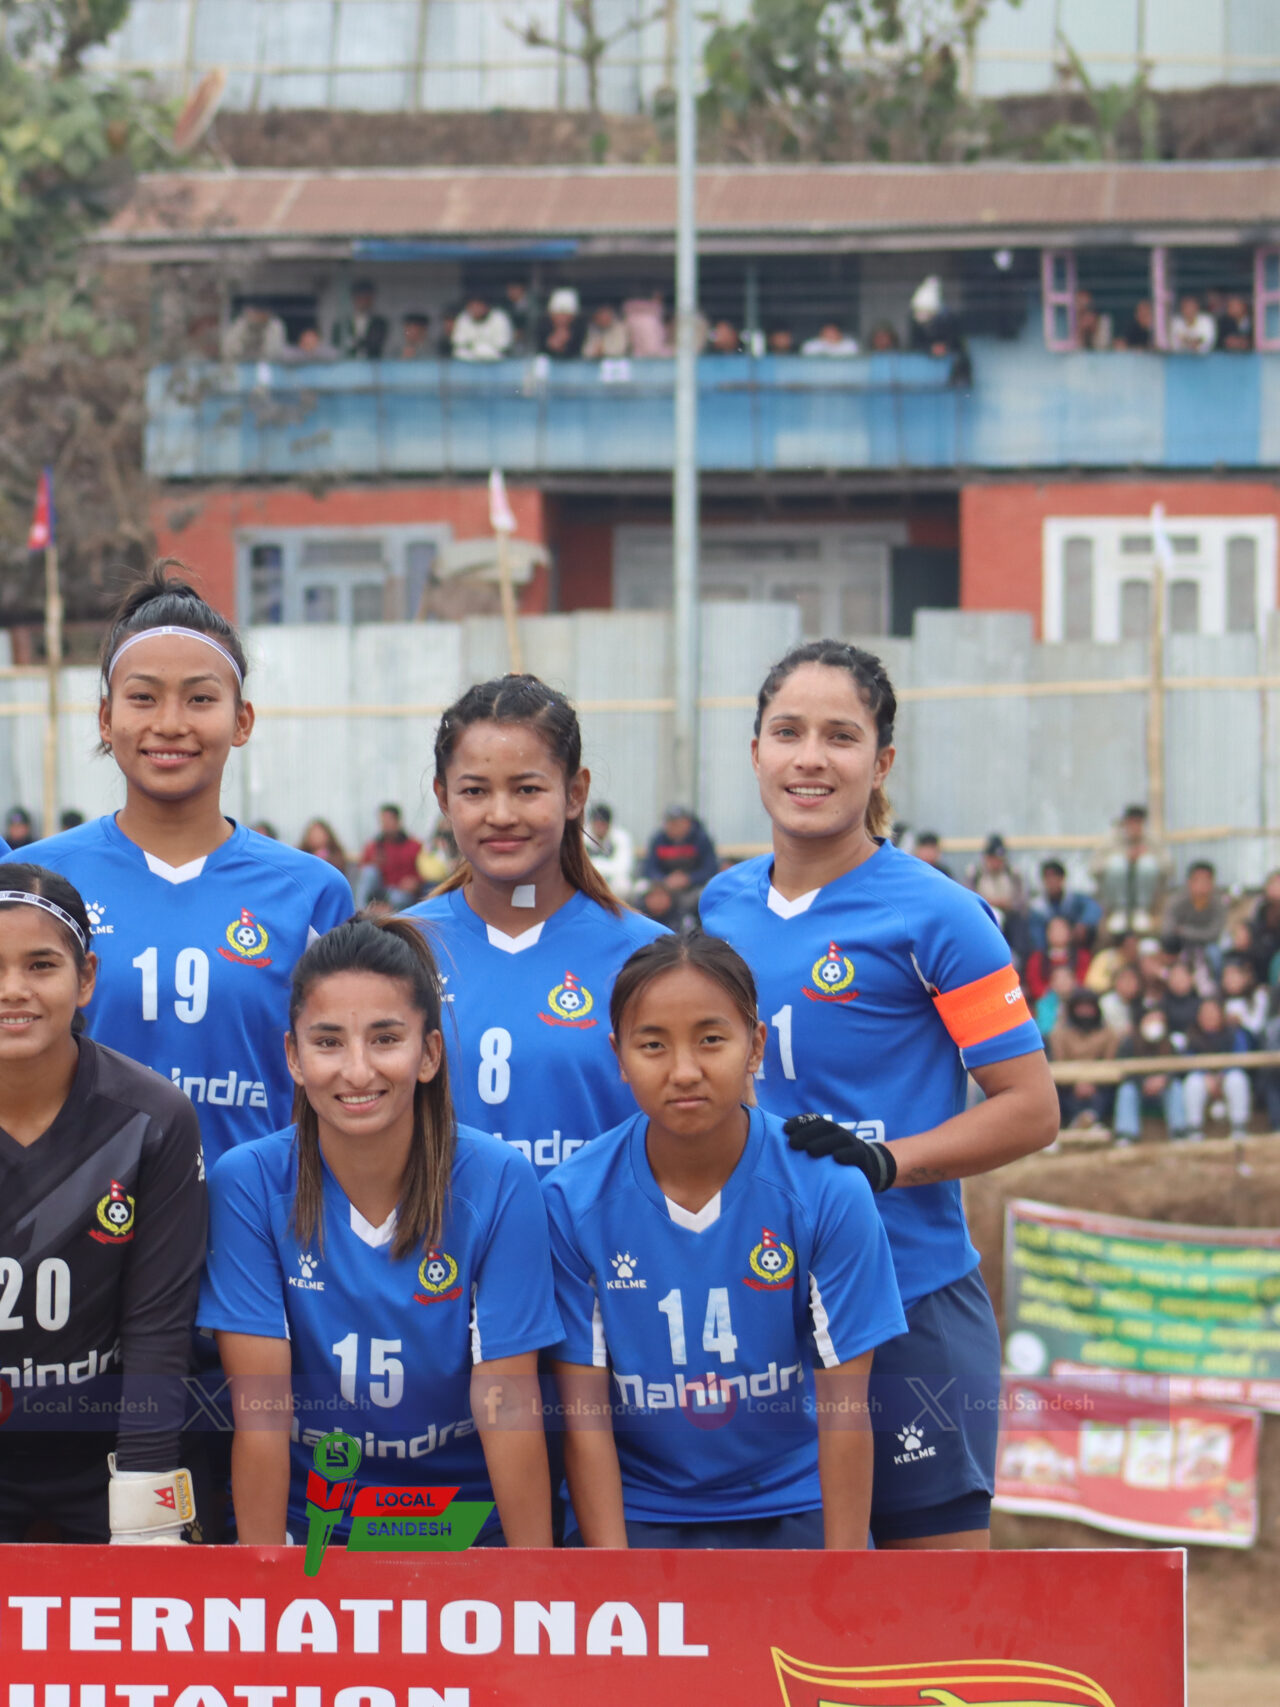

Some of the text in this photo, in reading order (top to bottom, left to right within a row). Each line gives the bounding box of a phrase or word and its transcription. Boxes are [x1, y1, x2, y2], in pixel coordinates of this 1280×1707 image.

[88, 925, 114, 935] LME
[132, 946, 210, 1024] 19
[478, 1027, 512, 1105] 8
[288, 1276, 325, 1291] KELME
[606, 1279, 648, 1290] KELME
[658, 1287, 738, 1365] 14
[332, 1332, 404, 1408] 15
[893, 1446, 936, 1465] KELME
